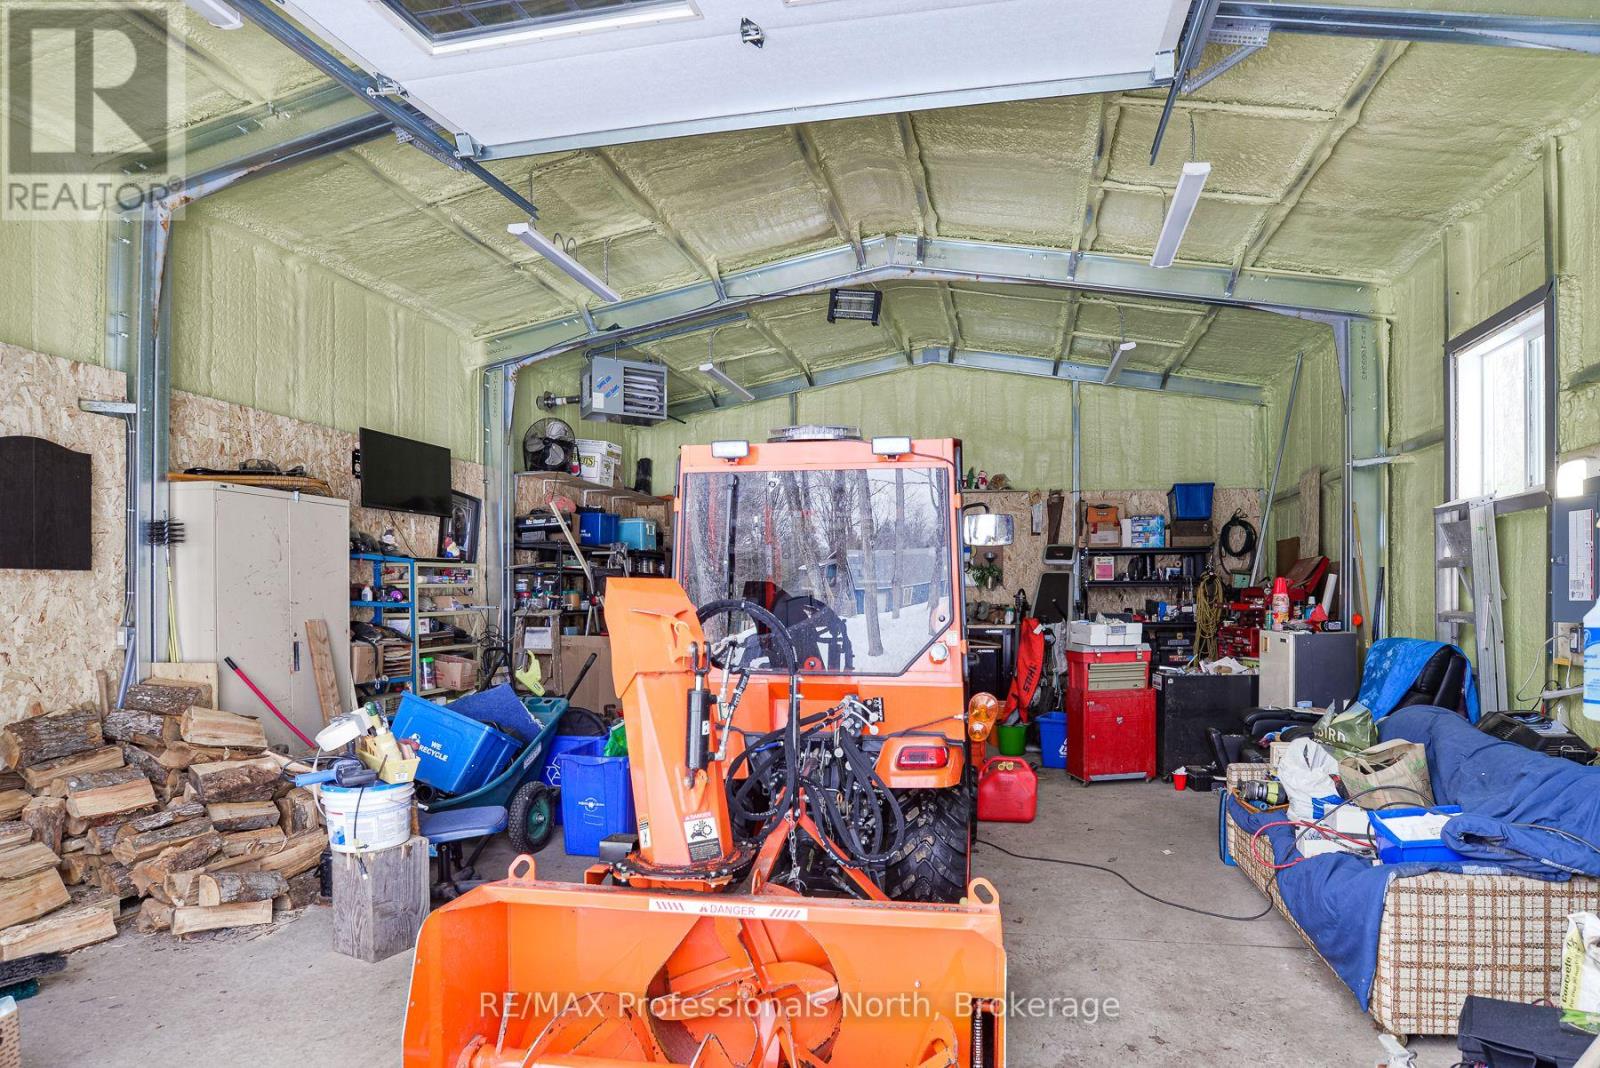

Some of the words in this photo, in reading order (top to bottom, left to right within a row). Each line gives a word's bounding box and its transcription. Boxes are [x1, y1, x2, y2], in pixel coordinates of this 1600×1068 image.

[430, 740, 443, 750] WE
[419, 744, 449, 762] RECYCLE
[709, 904, 756, 916] DANGER
